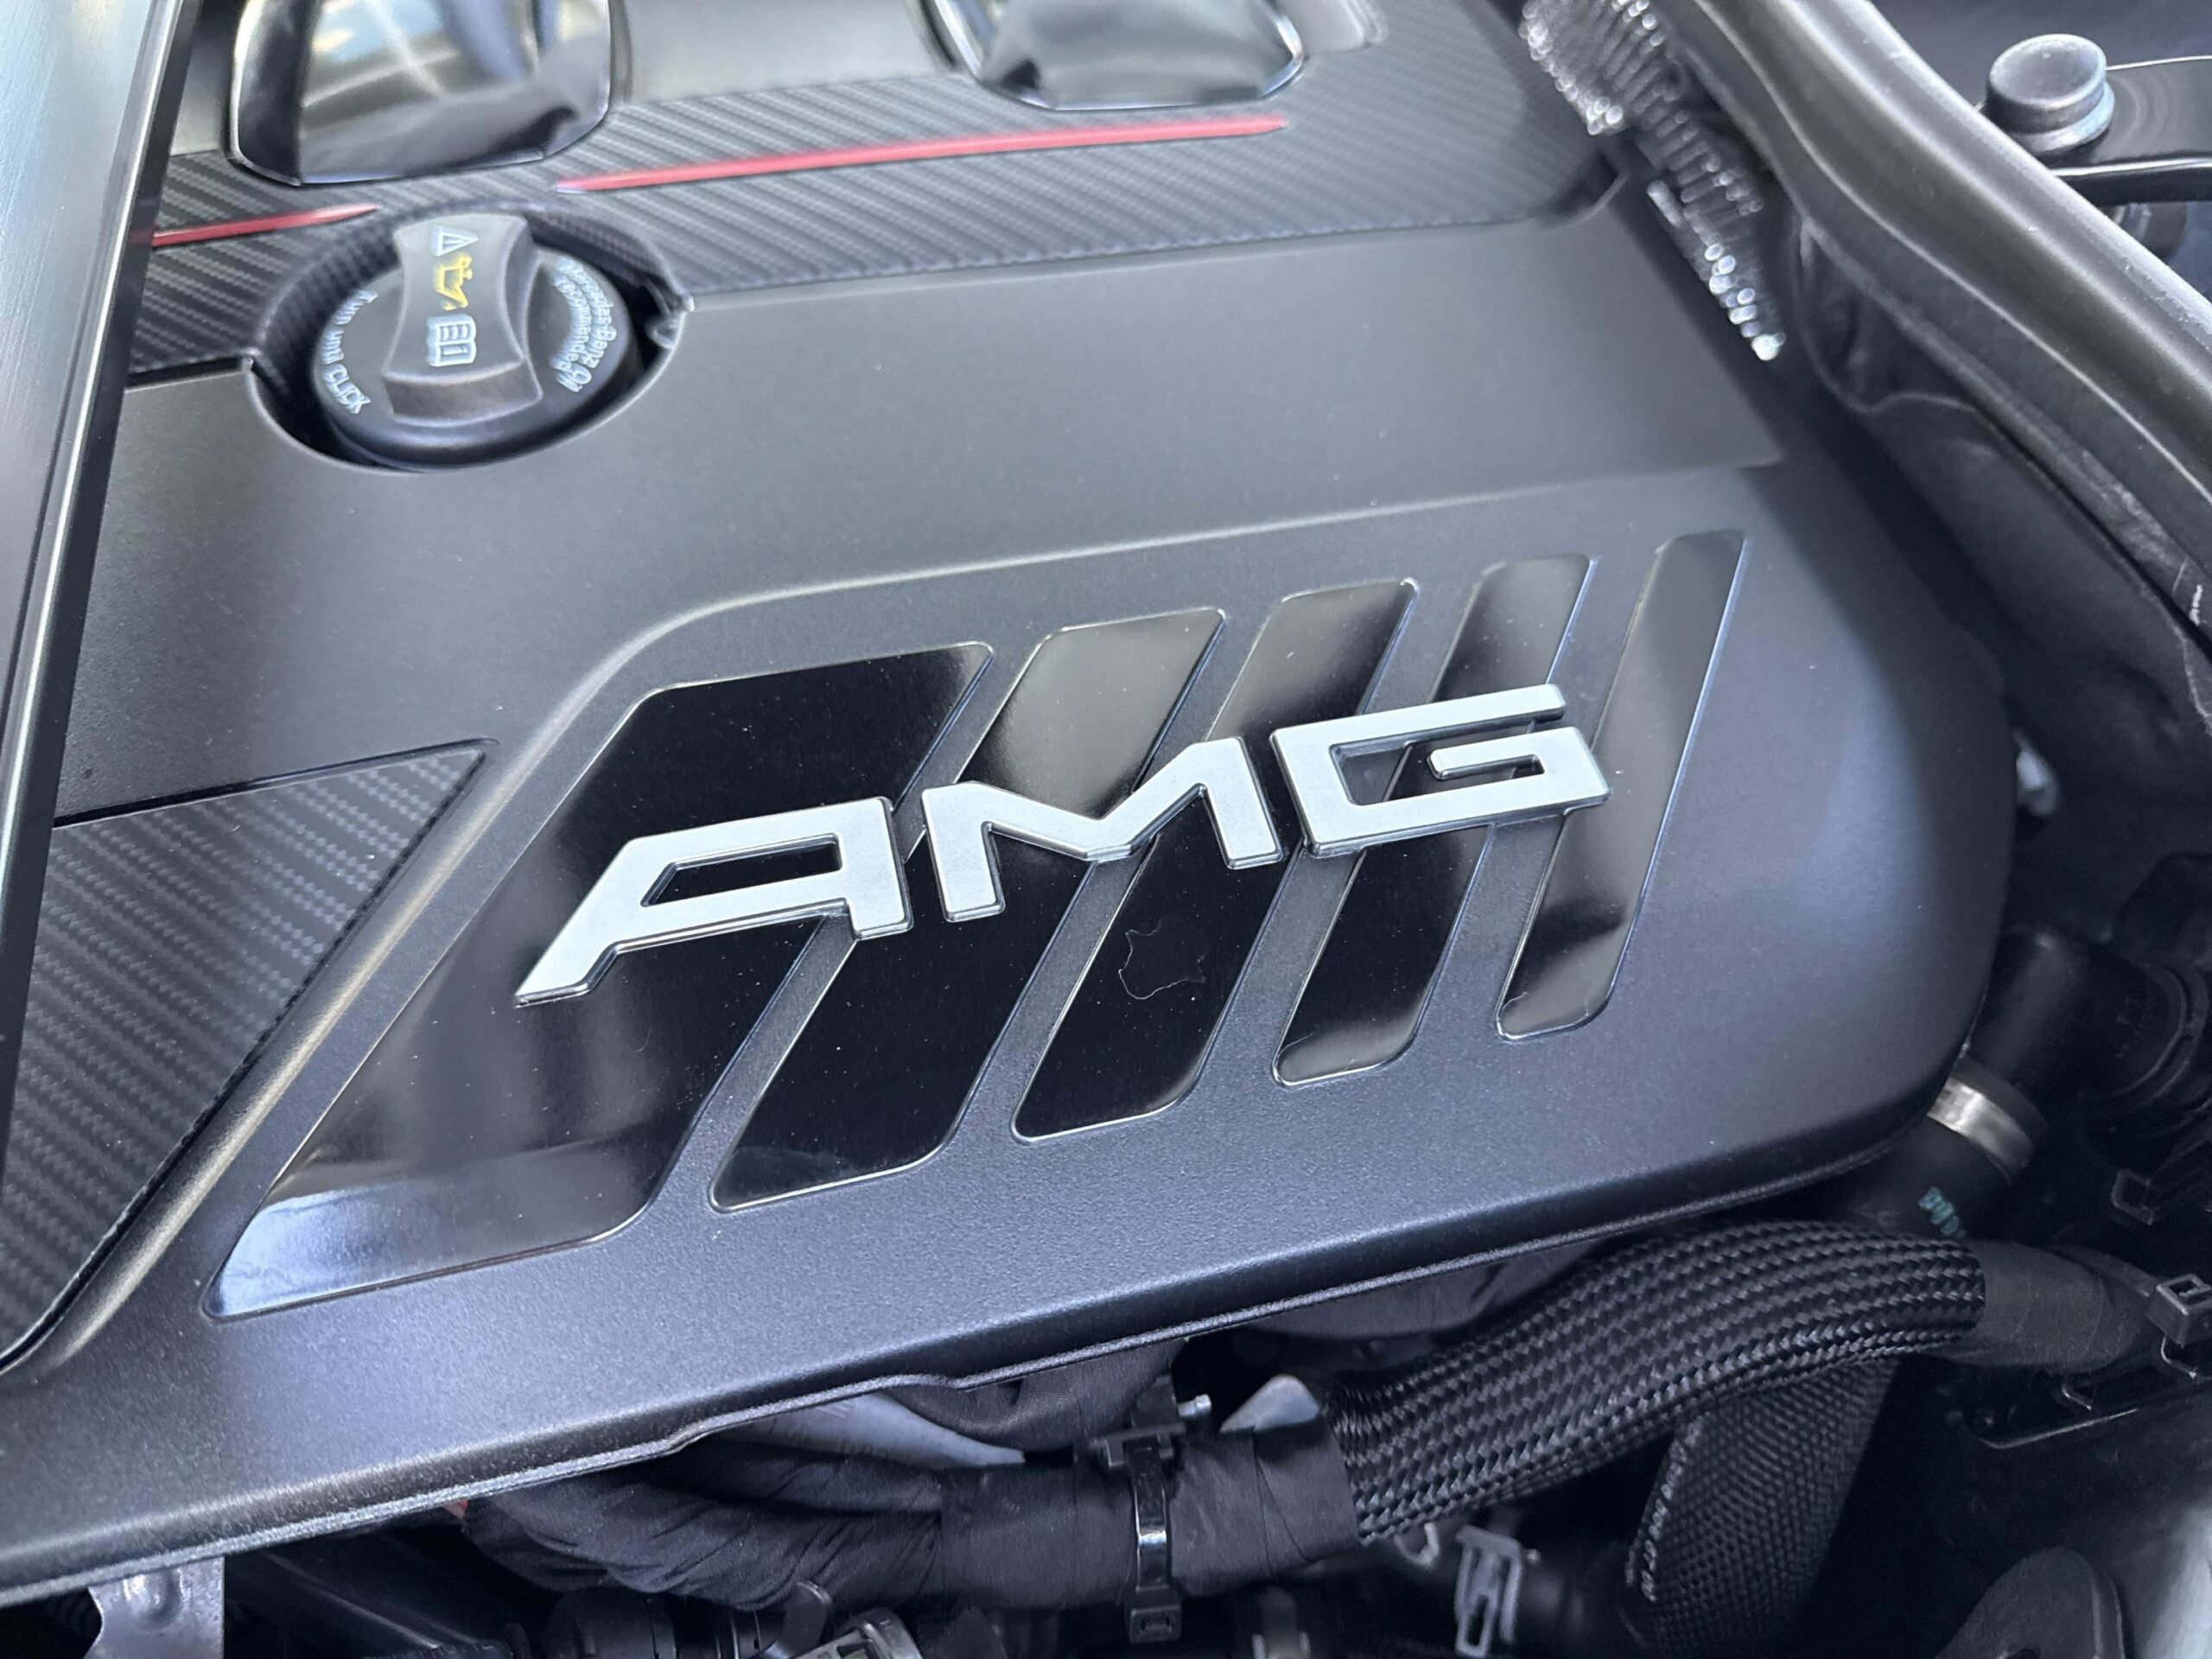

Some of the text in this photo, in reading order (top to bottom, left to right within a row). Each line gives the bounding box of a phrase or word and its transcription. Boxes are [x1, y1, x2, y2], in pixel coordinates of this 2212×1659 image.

[321, 290, 378, 414] Turn until CLICK
[550, 270, 592, 371] recommended
[516, 683, 1611, 1007] AMG
